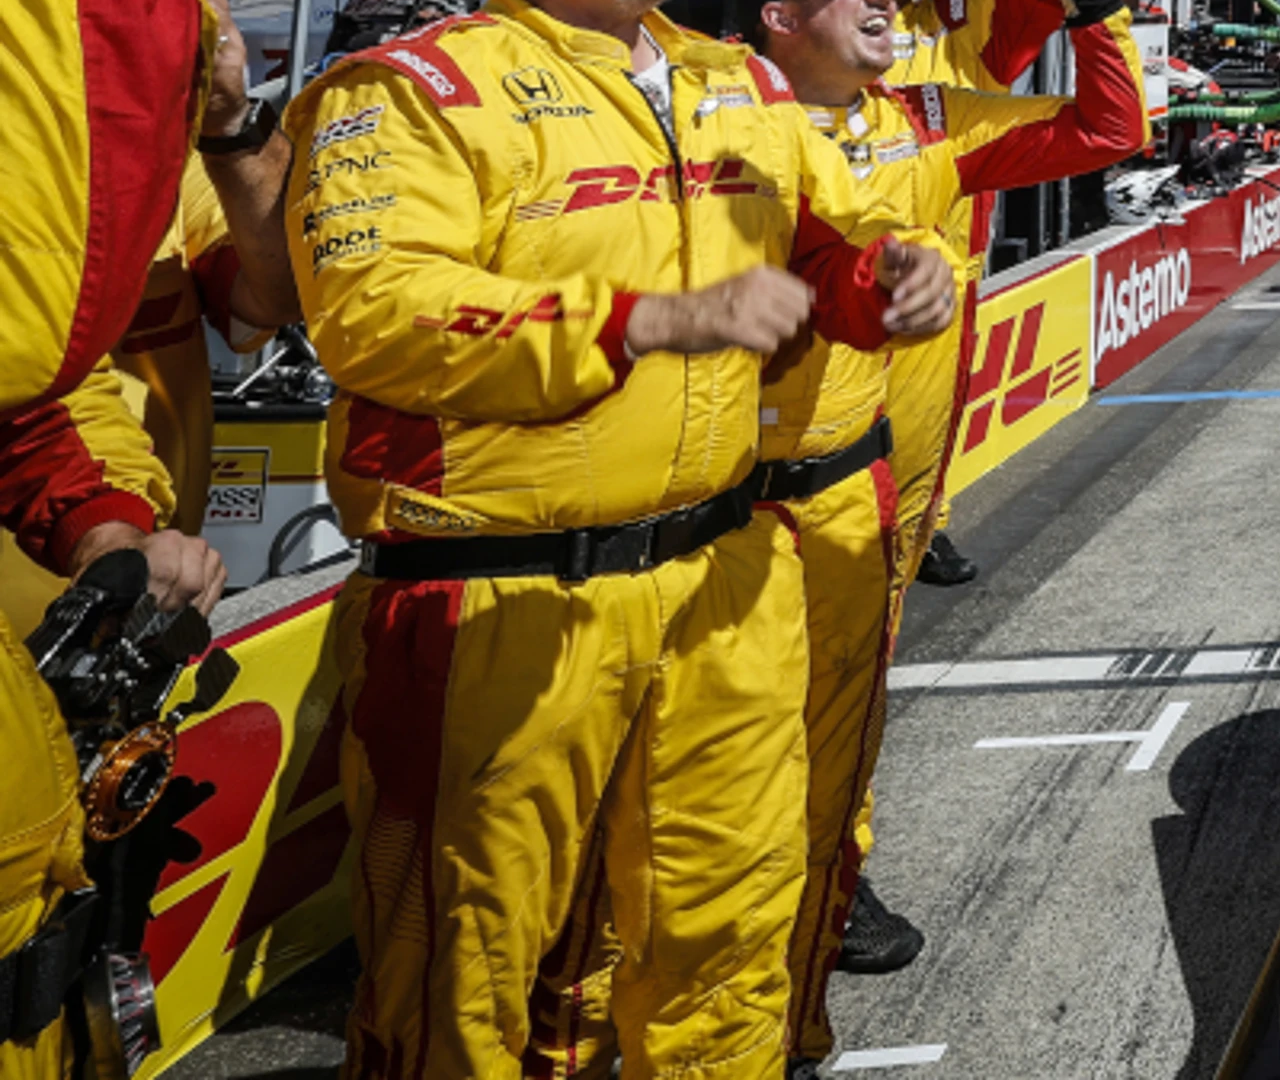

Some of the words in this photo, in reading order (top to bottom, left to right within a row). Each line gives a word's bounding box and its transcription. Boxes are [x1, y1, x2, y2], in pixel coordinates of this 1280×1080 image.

[323, 150, 392, 178] PNC
[562, 158, 759, 214] DHL
[1095, 247, 1192, 364] Astemo
